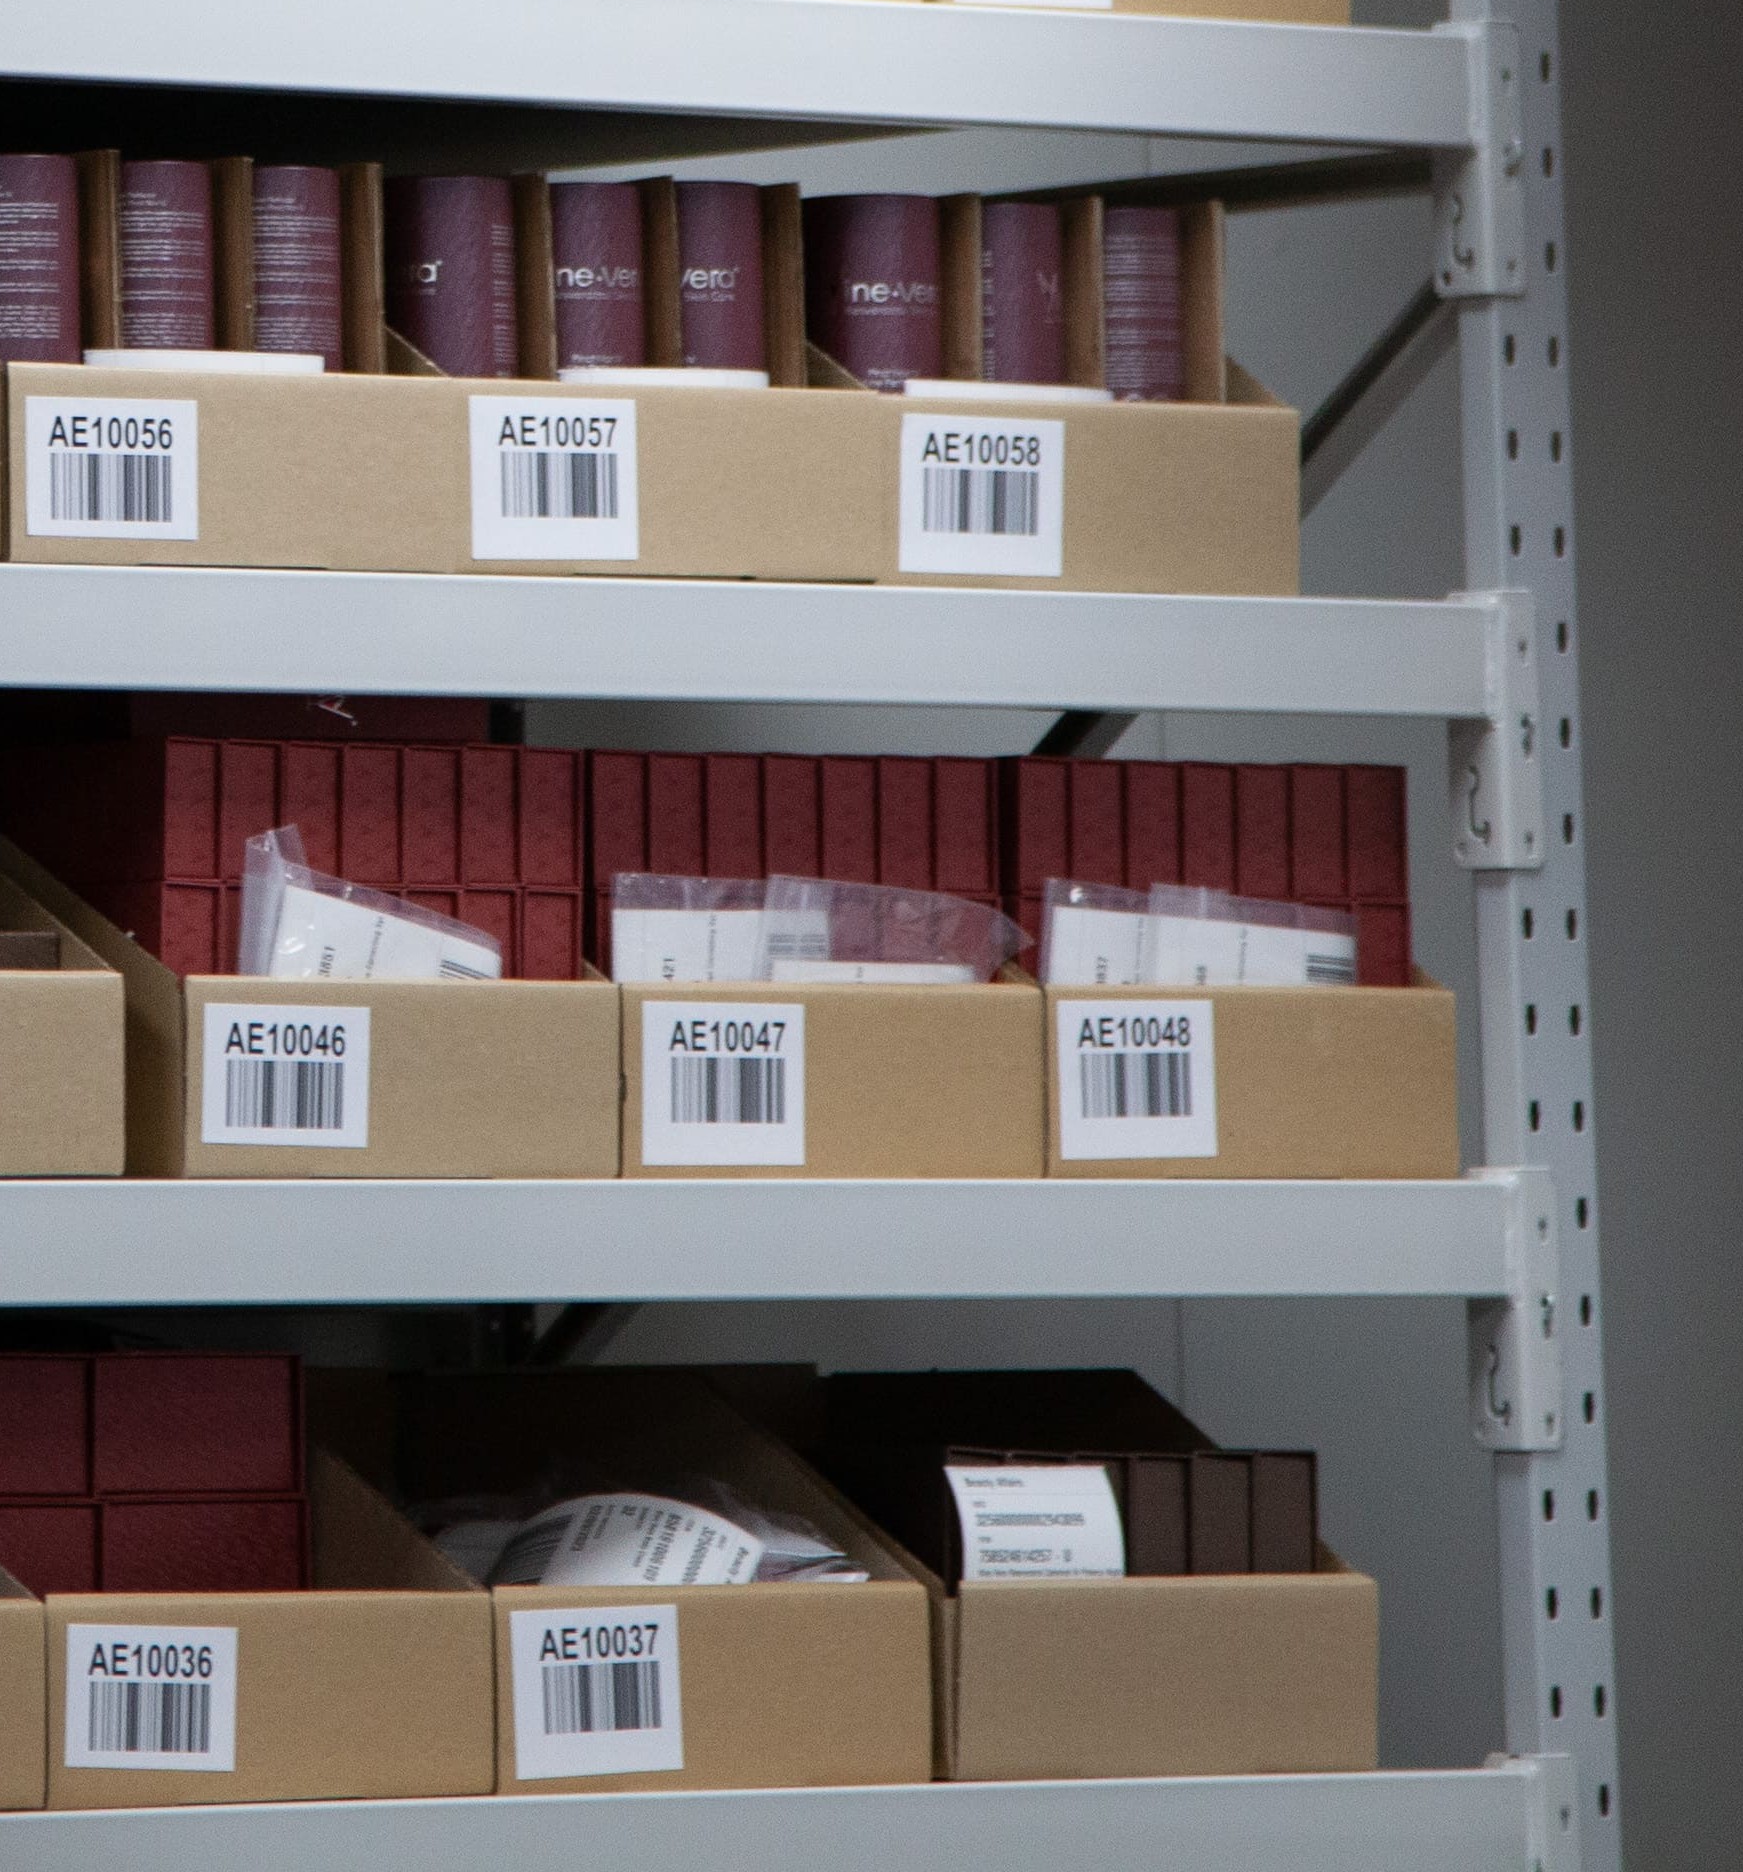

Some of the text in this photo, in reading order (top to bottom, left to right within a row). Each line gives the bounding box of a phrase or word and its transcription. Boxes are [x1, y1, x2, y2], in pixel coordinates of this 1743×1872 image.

[48, 415, 173, 450] AE10056
[498, 415, 617, 448] AE10057
[922, 432, 1041, 467] AE10058
[225, 1022, 345, 1057] AE10046
[669, 1020, 786, 1053] AE10047
[1078, 1016, 1191, 1048] AE10048
[540, 1623, 659, 1661] AE10037
[88, 1643, 213, 1679] AE10036
